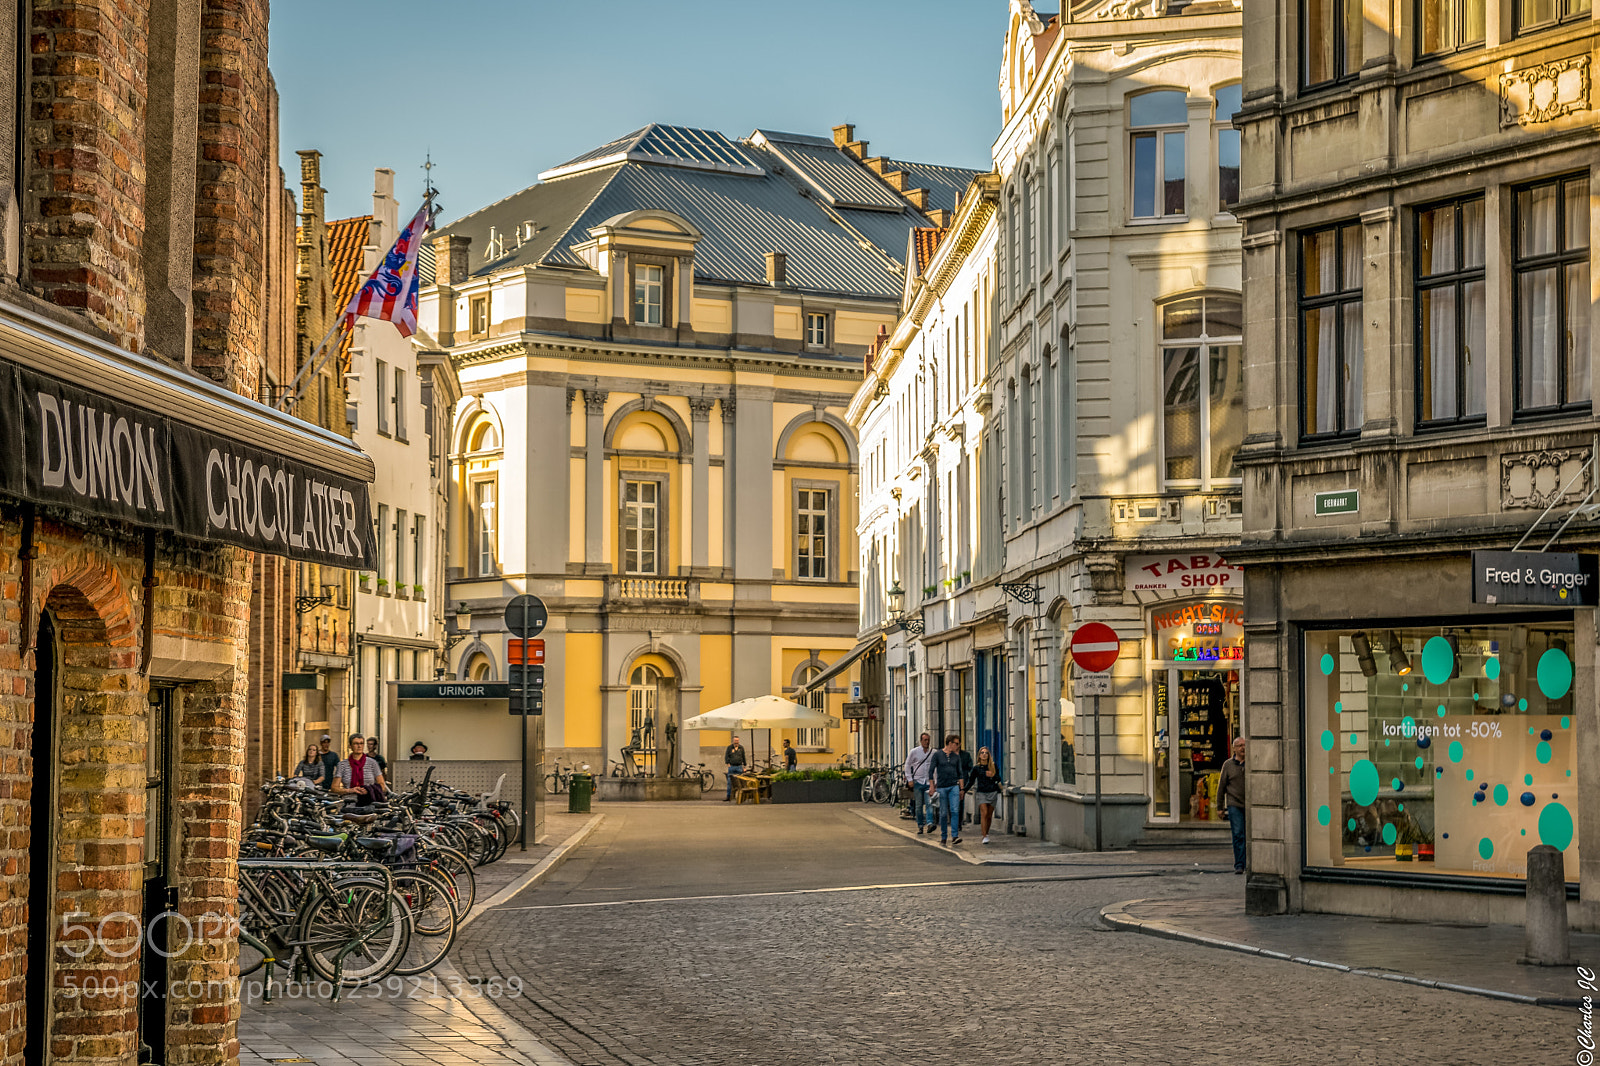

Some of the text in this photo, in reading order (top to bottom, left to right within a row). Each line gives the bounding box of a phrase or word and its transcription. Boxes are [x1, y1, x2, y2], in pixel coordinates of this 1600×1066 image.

[38, 392, 363, 558] DUMON CHOCOLATIER
[1141, 556, 1244, 577] TABA
[1181, 574, 1230, 587] SHOP
[1485, 567, 1590, 589] Fred & Ginger
[1153, 603, 1205, 631] NIGHT
[1196, 624, 1220, 633] OPEN
[438, 686, 485, 696] URINOIR
[1382, 720, 1502, 741] kortingen tot -50%
